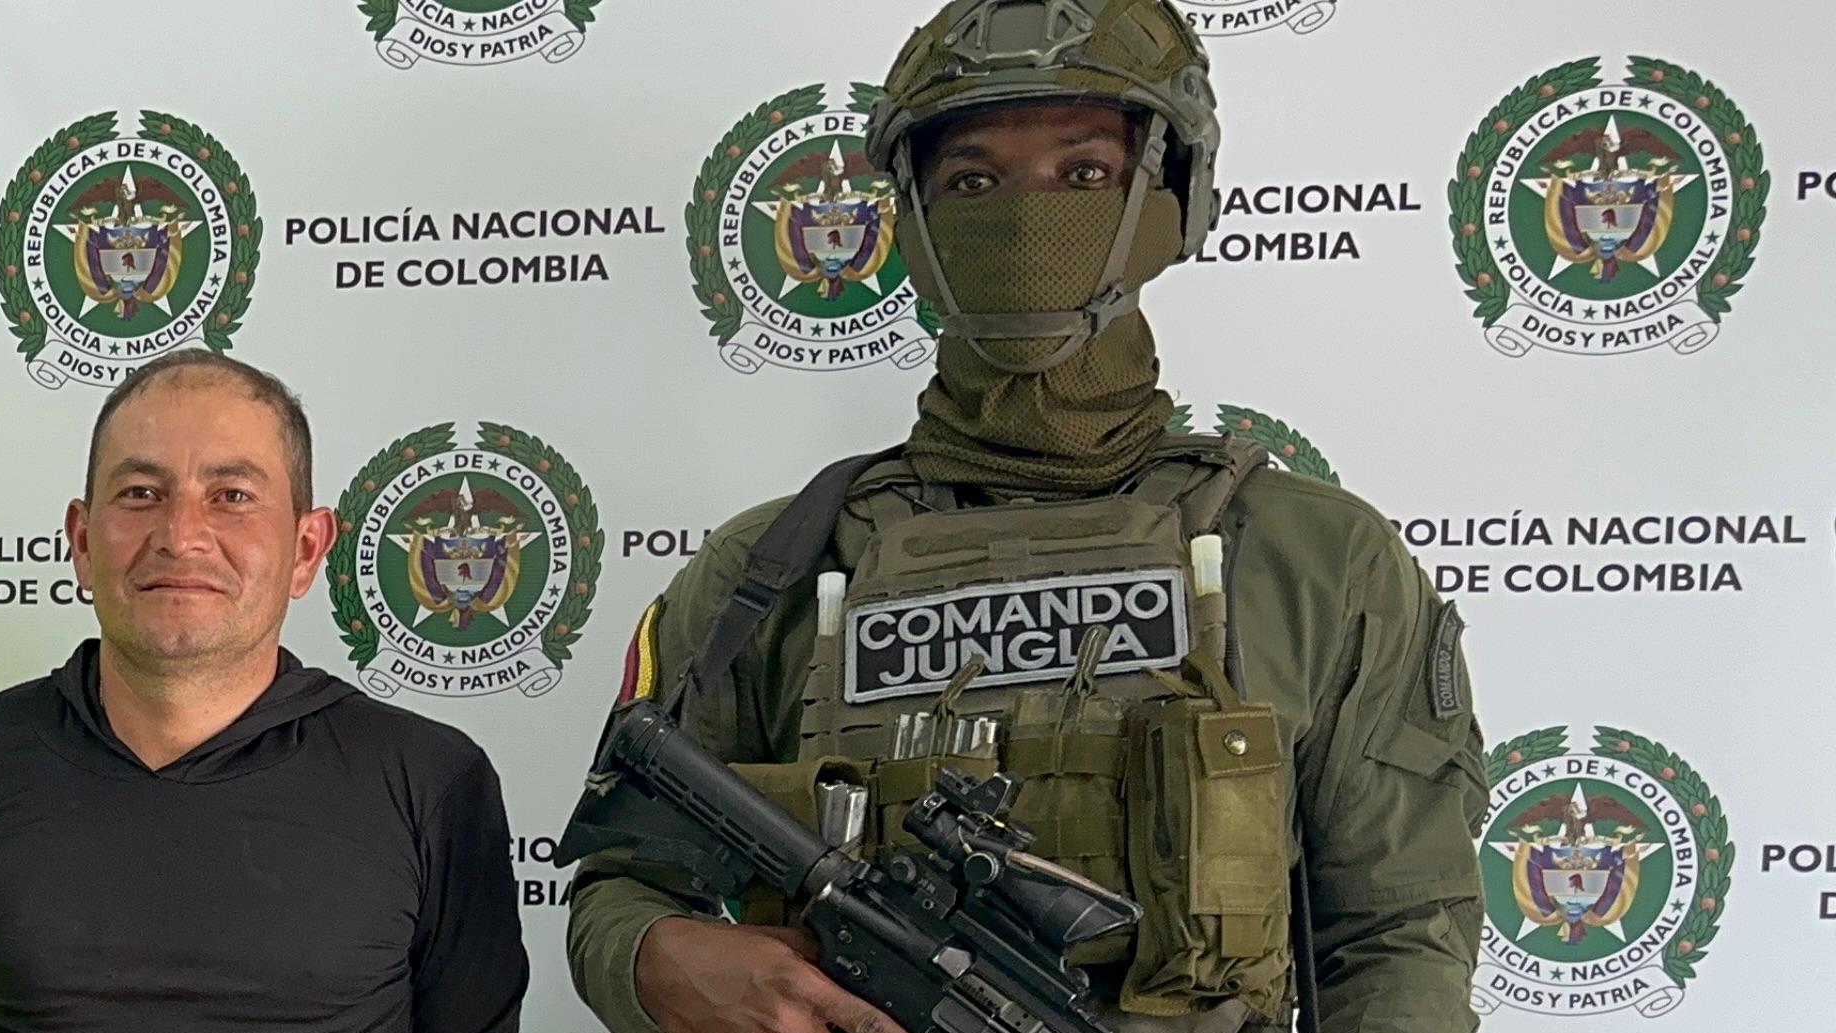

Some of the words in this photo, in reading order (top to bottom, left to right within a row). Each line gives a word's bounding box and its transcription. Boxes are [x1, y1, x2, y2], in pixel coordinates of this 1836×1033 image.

[482, 0, 547, 31] NACIO
[410, 28, 457, 57] DIOS
[462, 44, 474, 58] Y
[481, 25, 553, 58] PATRIA
[1489, 104, 1572, 224] REPÚBLICA
[1600, 91, 1632, 106] DE
[1659, 103, 1727, 219] COLOMBIA
[724, 129, 800, 246] REPÚBLICA
[825, 116, 855, 131] DE
[1222, 183, 1421, 215] ACIONAL
[27, 155, 95, 266] REPÚBLICA
[118, 143, 145, 157] DE
[168, 154, 227, 263] COLOMBIA
[286, 207, 440, 245] POLICÍA
[453, 206, 665, 240] NACIONAL
[1196, 231, 1359, 262] LOMBIA
[336, 261, 384, 288] DE
[397, 254, 609, 287] COLOMBIA
[1500, 253, 1572, 316] POLICÍA
[1605, 248, 1714, 319] NACIONAL
[38, 292, 100, 352] POLICÍA
[127, 289, 217, 355] NACIONAL
[733, 273, 801, 334] POLICÍA
[831, 286, 913, 336] NACION
[755, 333, 804, 362] DIOS
[809, 349, 822, 364] Y
[829, 331, 904, 364] PATRIA
[1522, 315, 1576, 345] DIOS
[1581, 332, 1595, 347] Y
[1603, 314, 1684, 347] PATRIA
[58, 351, 104, 379] DIOS
[107, 367, 119, 381] Y
[360, 466, 431, 576] REPÚBLICA
[455, 454, 483, 469] DE
[506, 466, 567, 574] COLOMBIA
[1568, 516, 1806, 545] NACIONAL
[1436, 565, 1489, 592] DE
[1504, 564, 1742, 592] COLOMBIA
[370, 601, 434, 661] POLICÍA
[462, 600, 556, 664] NACIONAL
[859, 583, 1169, 650] COMANDO
[391, 659, 437, 688] DIOS
[442, 676, 454, 690] Y
[460, 660, 530, 690] PATRIA
[1438, 649, 1455, 708] COMANDO
[1567, 760, 1599, 775] DE
[1625, 773, 1693, 887] COLOMBIA
[1481, 926, 1540, 976] OLICÍA
[1572, 916, 1679, 981] NACIONAL
[1491, 975, 1543, 1005] DIOS
[1548, 993, 1561, 1007] Y
[1570, 978, 1649, 1008] PATRIA
